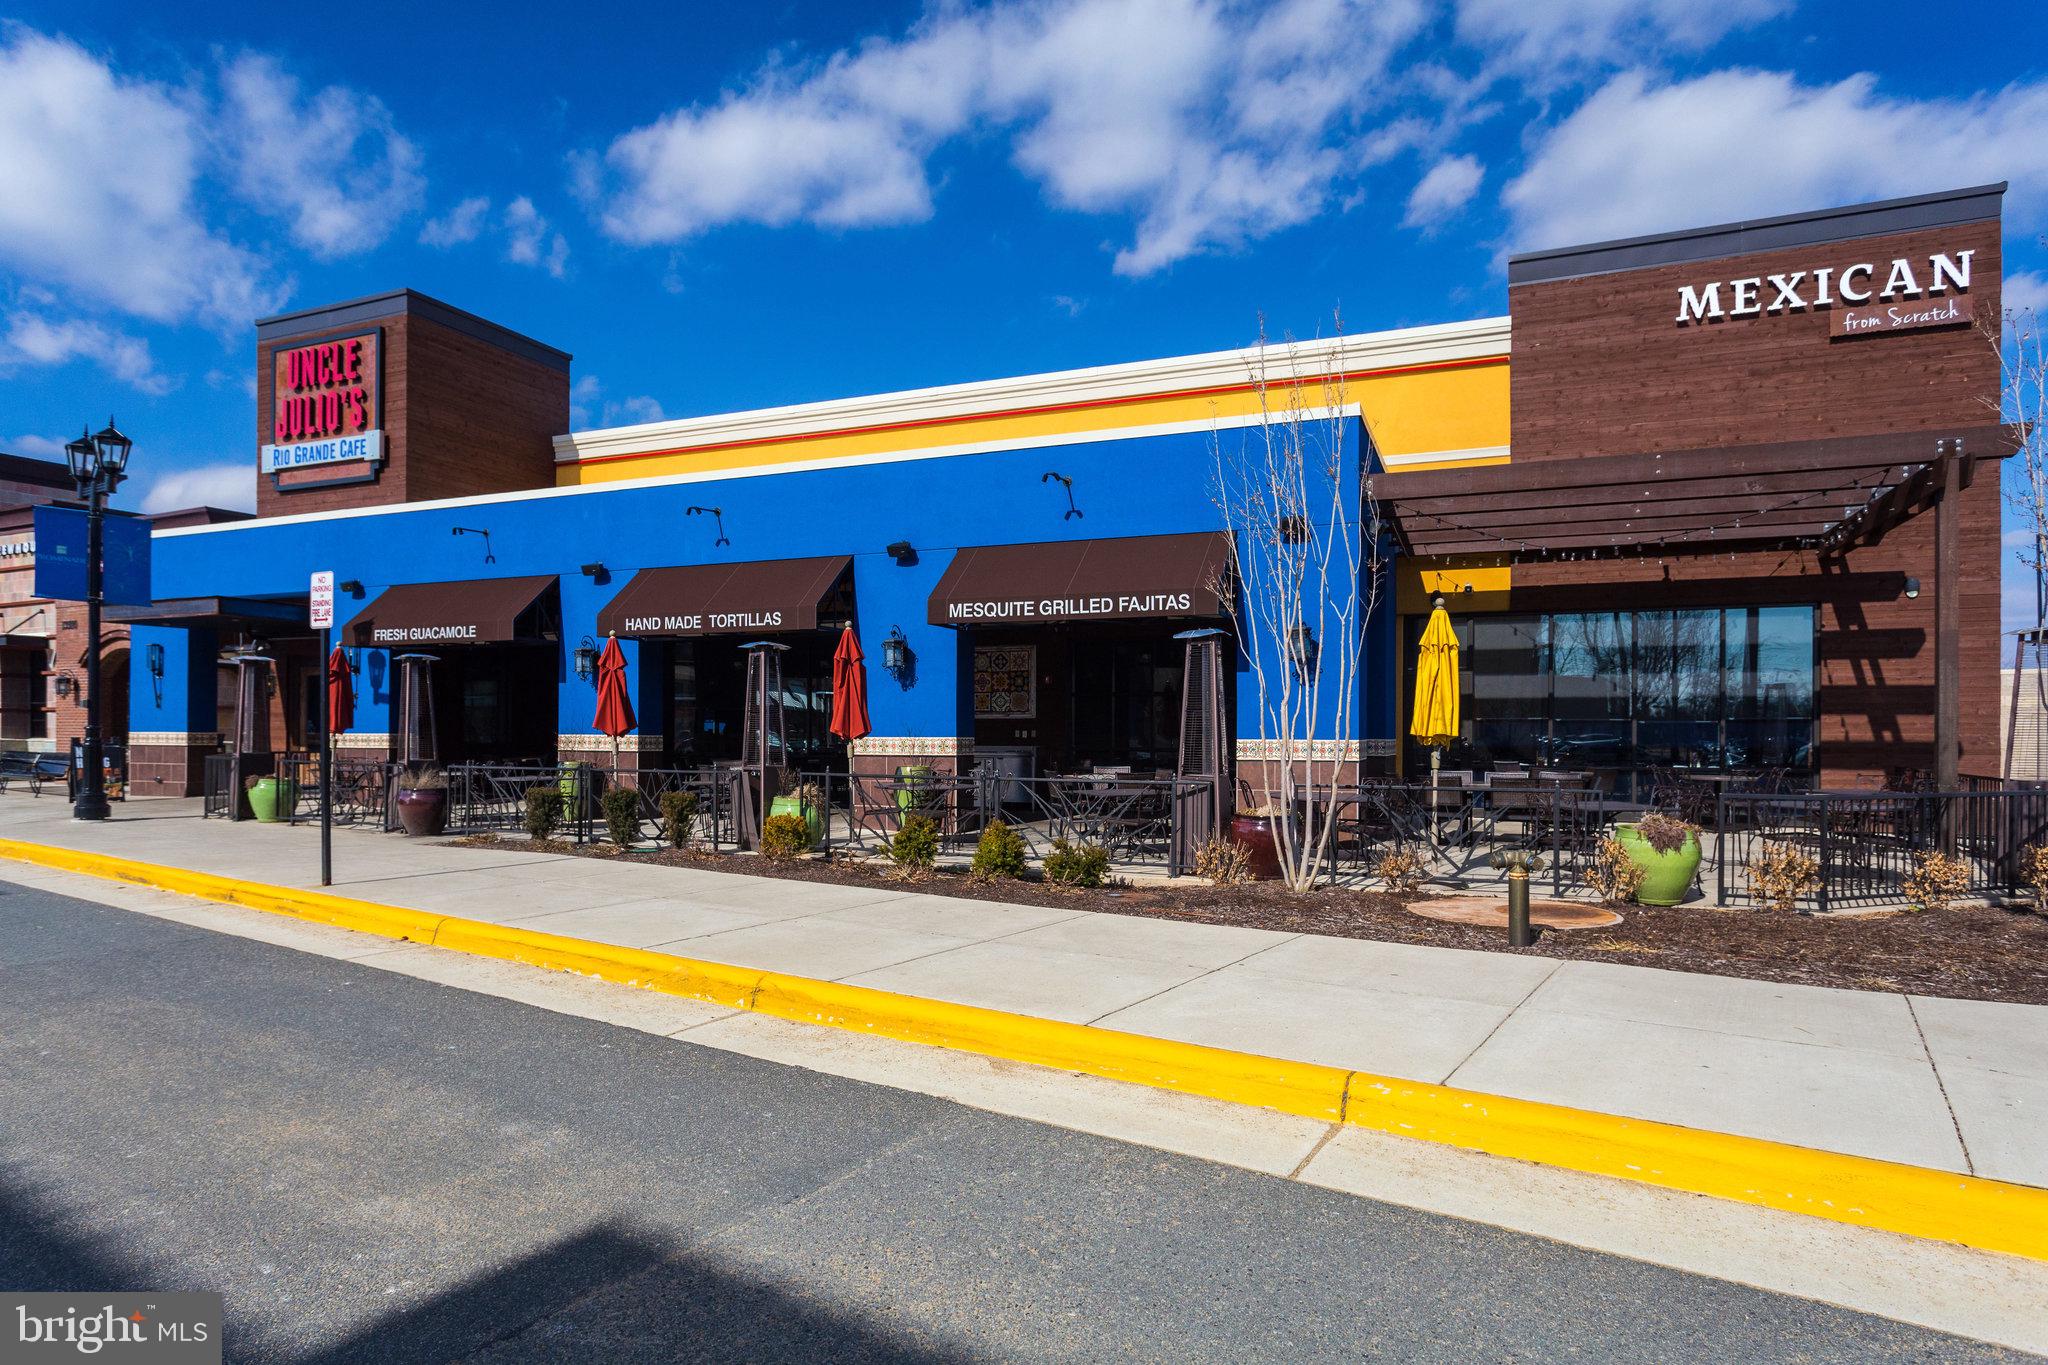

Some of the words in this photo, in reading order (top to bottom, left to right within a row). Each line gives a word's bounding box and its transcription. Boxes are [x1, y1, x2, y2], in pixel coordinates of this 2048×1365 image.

[1676, 249, 1975, 322] MEXICAN
[1843, 311, 1881, 332] from
[1887, 299, 1960, 328] Scratch
[287, 339, 358, 390] UNCLE
[275, 386, 364, 438] JULIO'S
[273, 448, 290, 467] RIO
[294, 443, 336, 464] GRANDE
[317, 576, 326, 584] NO
[312, 599, 332, 607] STANDING
[949, 601, 1034, 619] MESQUITE
[1039, 597, 1113, 615] GRILLED
[1118, 593, 1191, 612] FAJITAS
[374, 628, 408, 641] FRESH
[409, 625, 477, 640] GUACAMOLE
[625, 617, 661, 631] HAND
[664, 615, 701, 630] MADE
[709, 611, 782, 628] TORTILLAS
